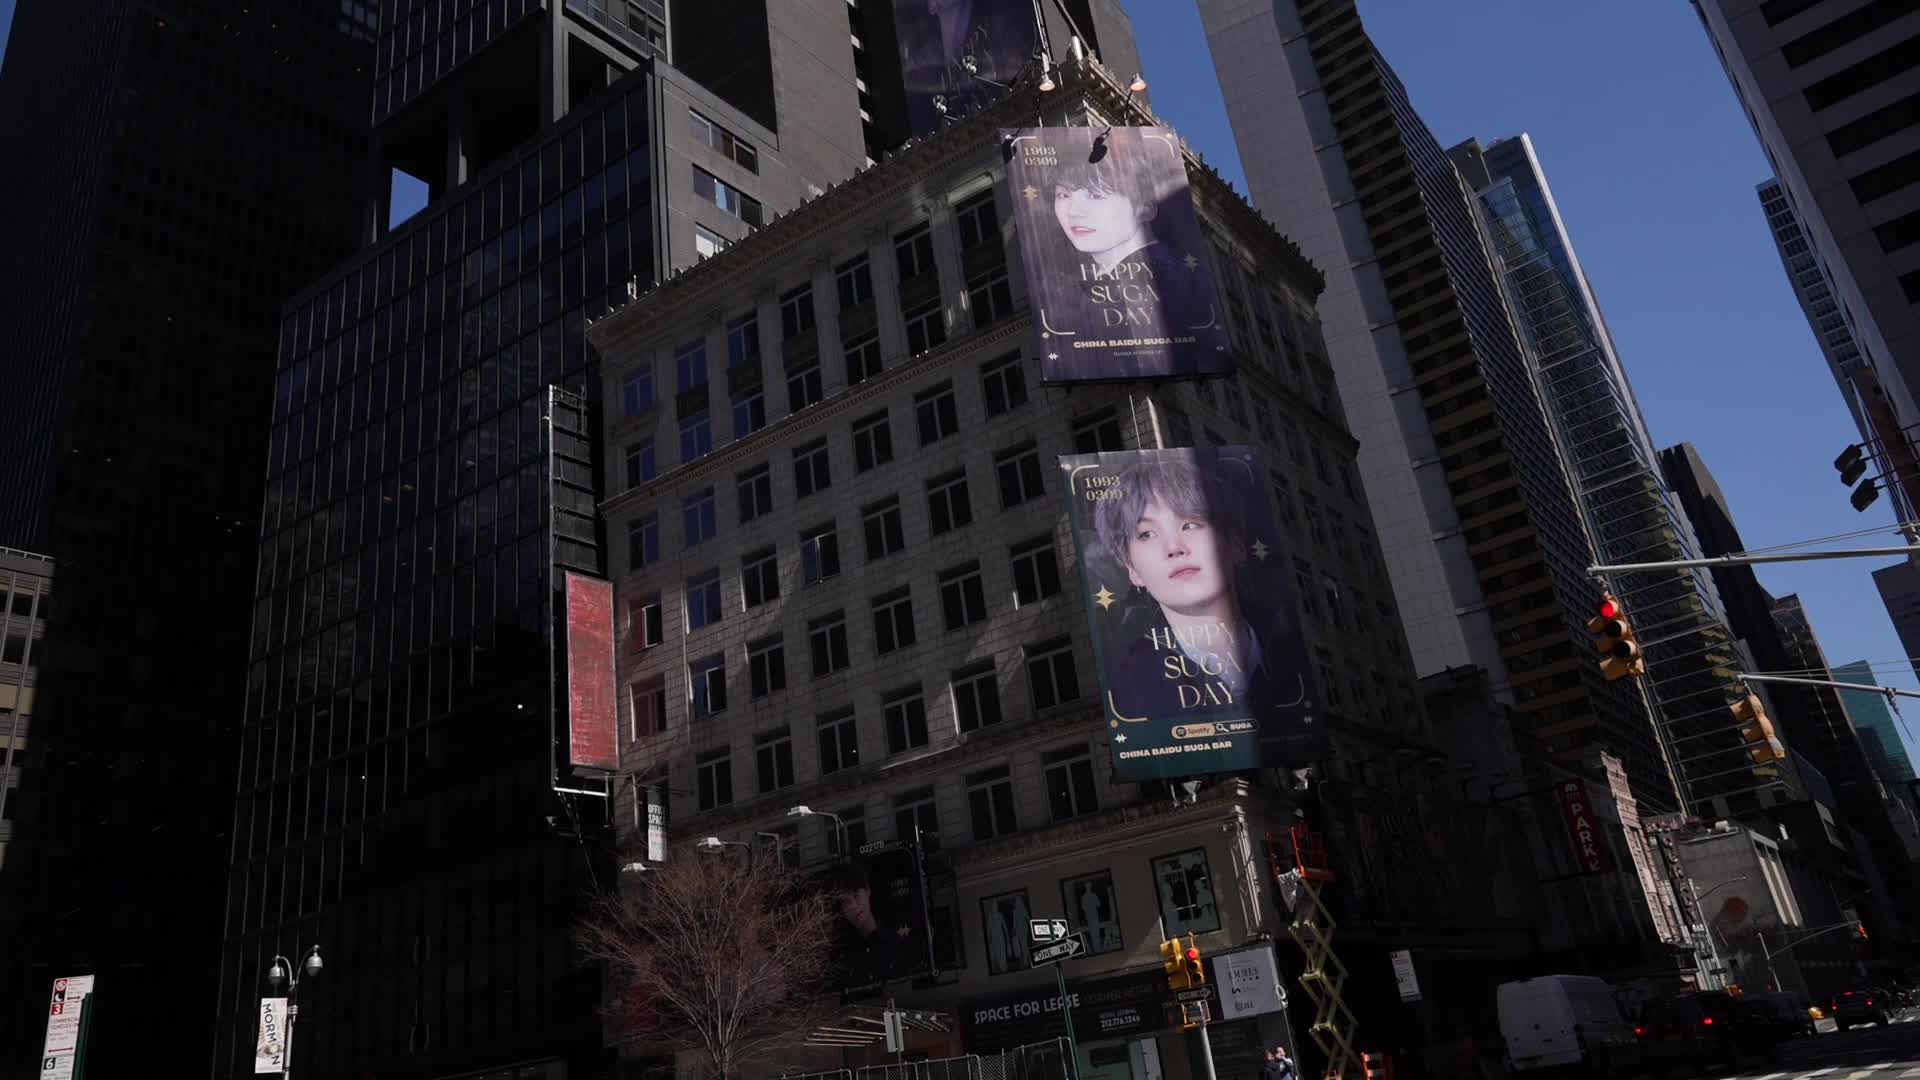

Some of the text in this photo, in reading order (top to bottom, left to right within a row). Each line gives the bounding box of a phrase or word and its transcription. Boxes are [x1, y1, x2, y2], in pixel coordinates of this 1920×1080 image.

[1080, 261, 1155, 281] HAPPY
[1091, 284, 1160, 303] SUGA
[1103, 307, 1153, 327] DAY
[1073, 340, 1107, 348] CHINA
[1109, 338, 1141, 347] BAIDU
[1143, 336, 1173, 345] SUGA
[1085, 475, 1121, 488] 1993
[1151, 622, 1235, 651] HAPPY
[1164, 652, 1242, 679] SUGA
[1178, 681, 1233, 708] DAY
[1187, 722, 1253, 736] Spotify SUGA
[1120, 740, 1232, 759] CHINA BAIDU SUGA BAR
[1037, 941, 1074, 960] ONE WAY
[53, 1004, 62, 1015] 3
[975, 1004, 1011, 1024] SPACE
[1014, 1000, 1041, 1017] FOR
[1043, 993, 1080, 1013] LEASE
[45, 1058, 54, 1070] 6
